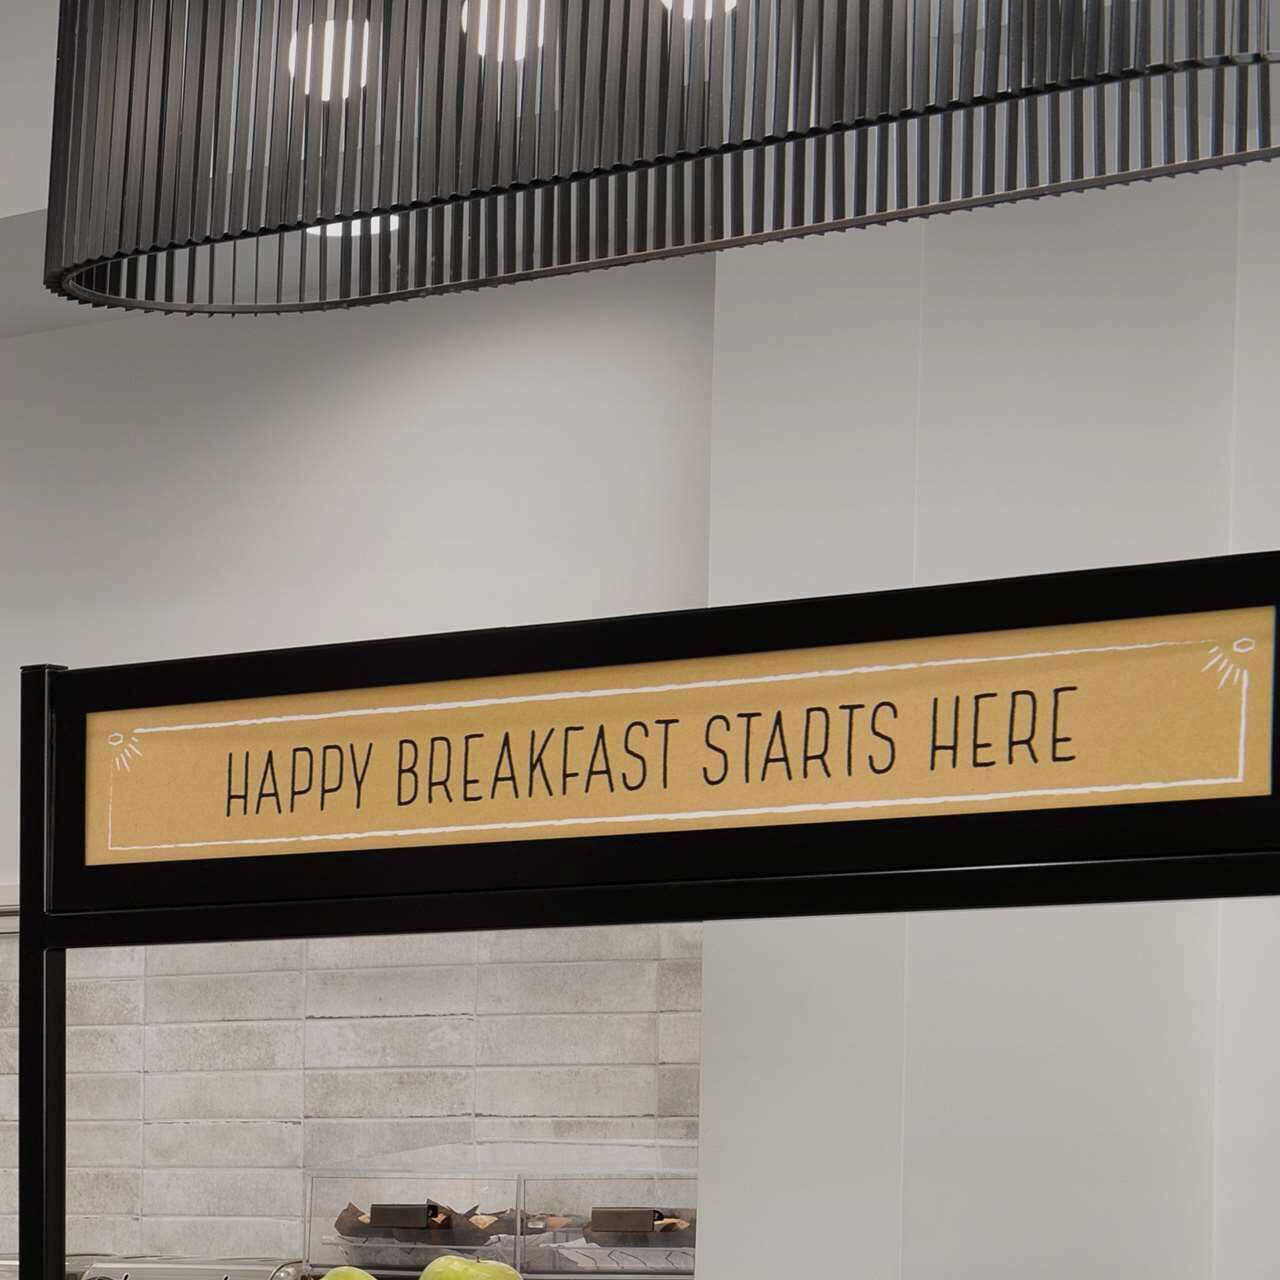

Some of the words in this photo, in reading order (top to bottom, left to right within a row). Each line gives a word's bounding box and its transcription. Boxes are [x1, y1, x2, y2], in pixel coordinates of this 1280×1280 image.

[225, 742, 374, 818] HAPPY
[396, 717, 680, 807] BREAKFAST
[701, 700, 899, 787] STARTS
[928, 684, 1079, 772] HERE
